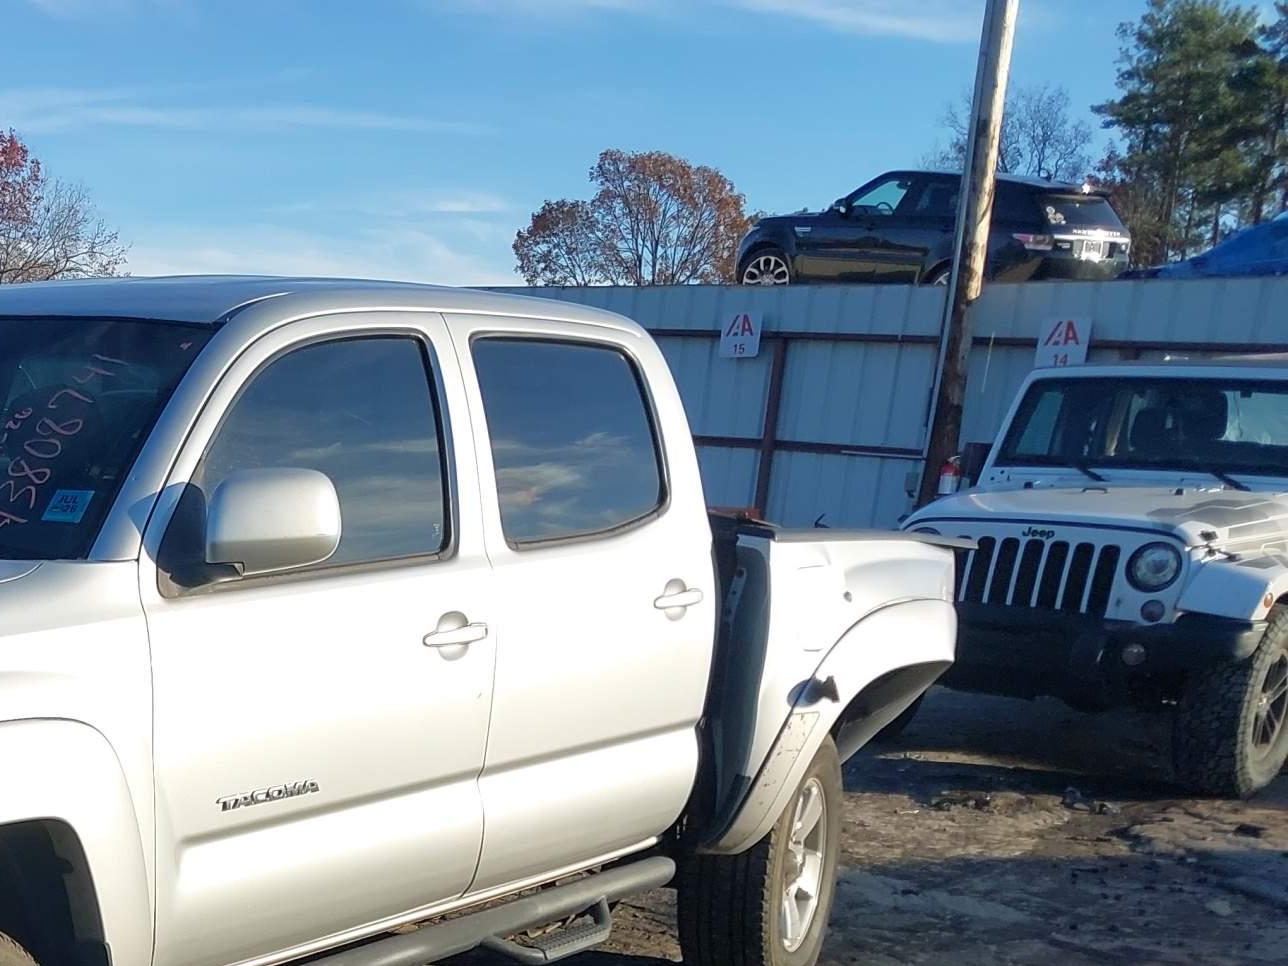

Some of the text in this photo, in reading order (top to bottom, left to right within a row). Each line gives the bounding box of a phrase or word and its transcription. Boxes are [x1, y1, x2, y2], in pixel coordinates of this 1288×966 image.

[733, 343, 745, 354] 15
[1053, 353, 1069, 367] 14
[1022, 526, 1056, 540] Jeep
[215, 780, 320, 812] TACOMA
